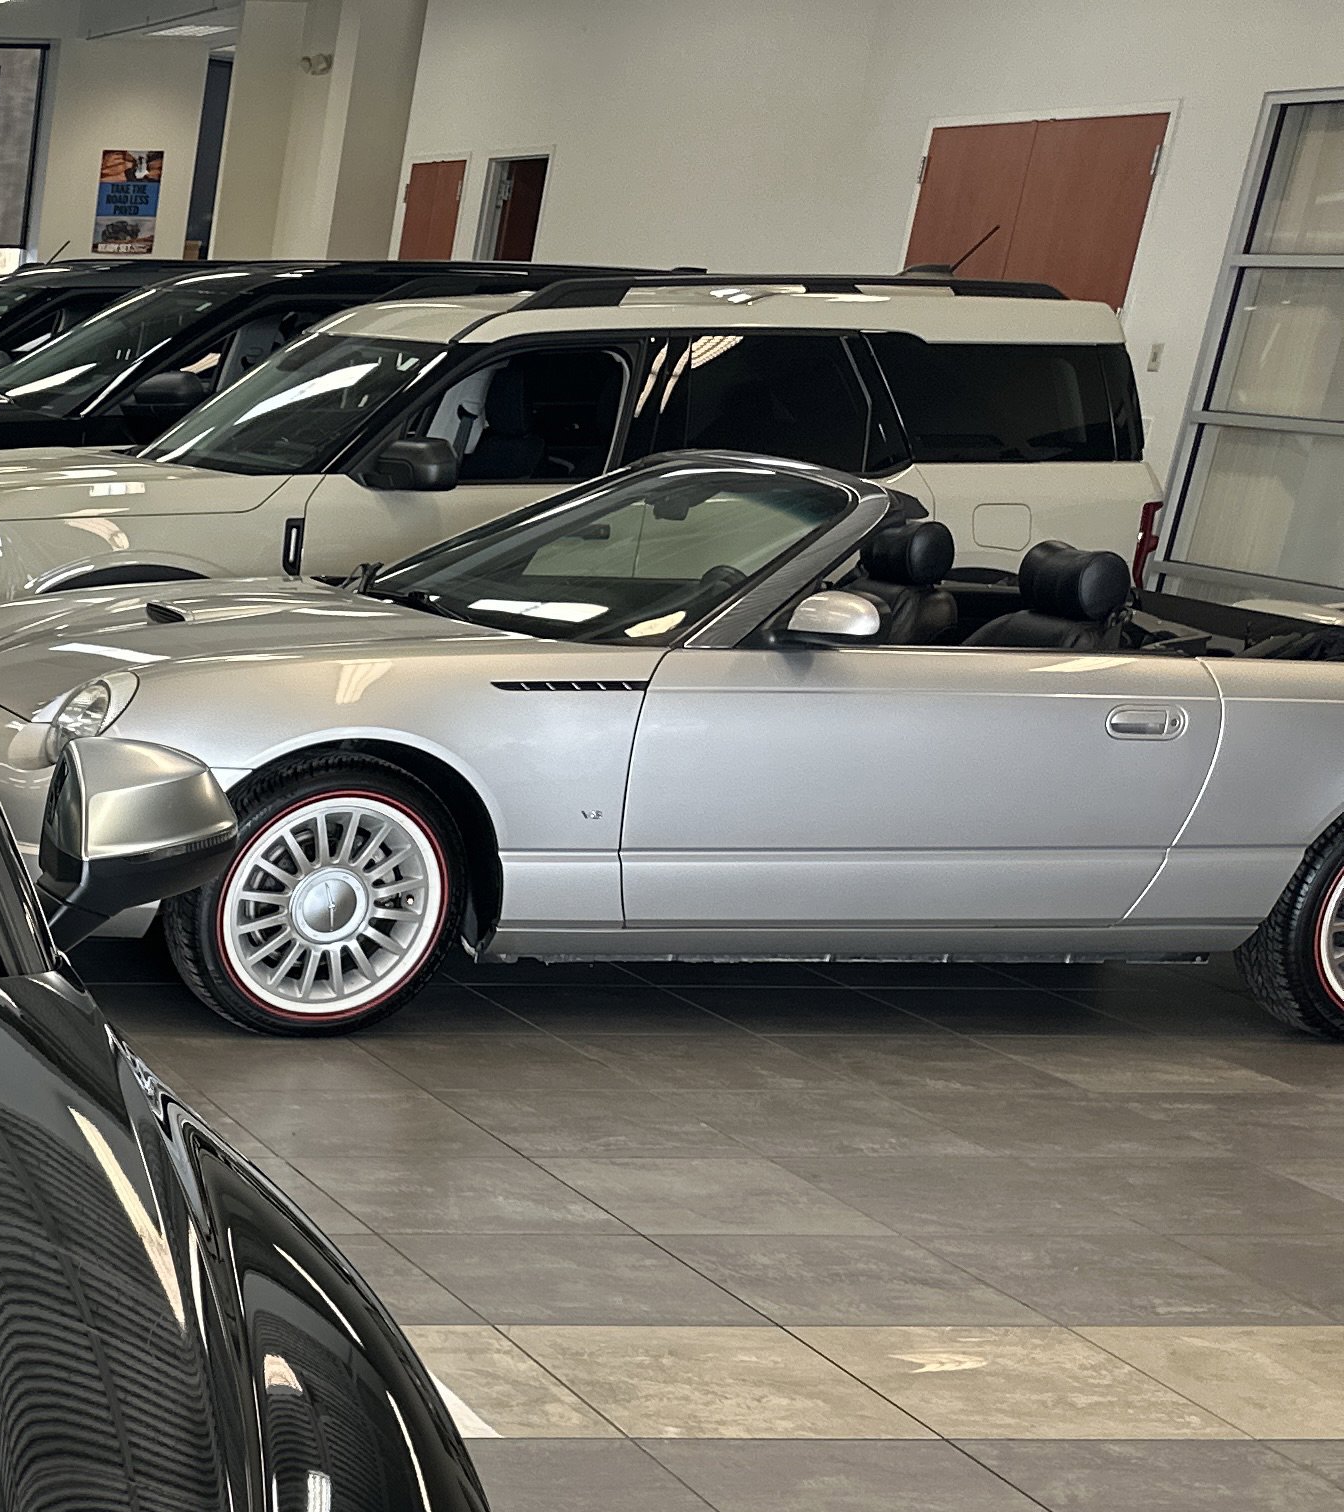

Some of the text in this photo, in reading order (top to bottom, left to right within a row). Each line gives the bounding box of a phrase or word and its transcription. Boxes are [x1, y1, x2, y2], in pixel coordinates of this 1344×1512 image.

[111, 183, 148, 195] TAKE THE
[105, 194, 150, 205] ROAD LESS
[113, 205, 140, 216] PAVED
